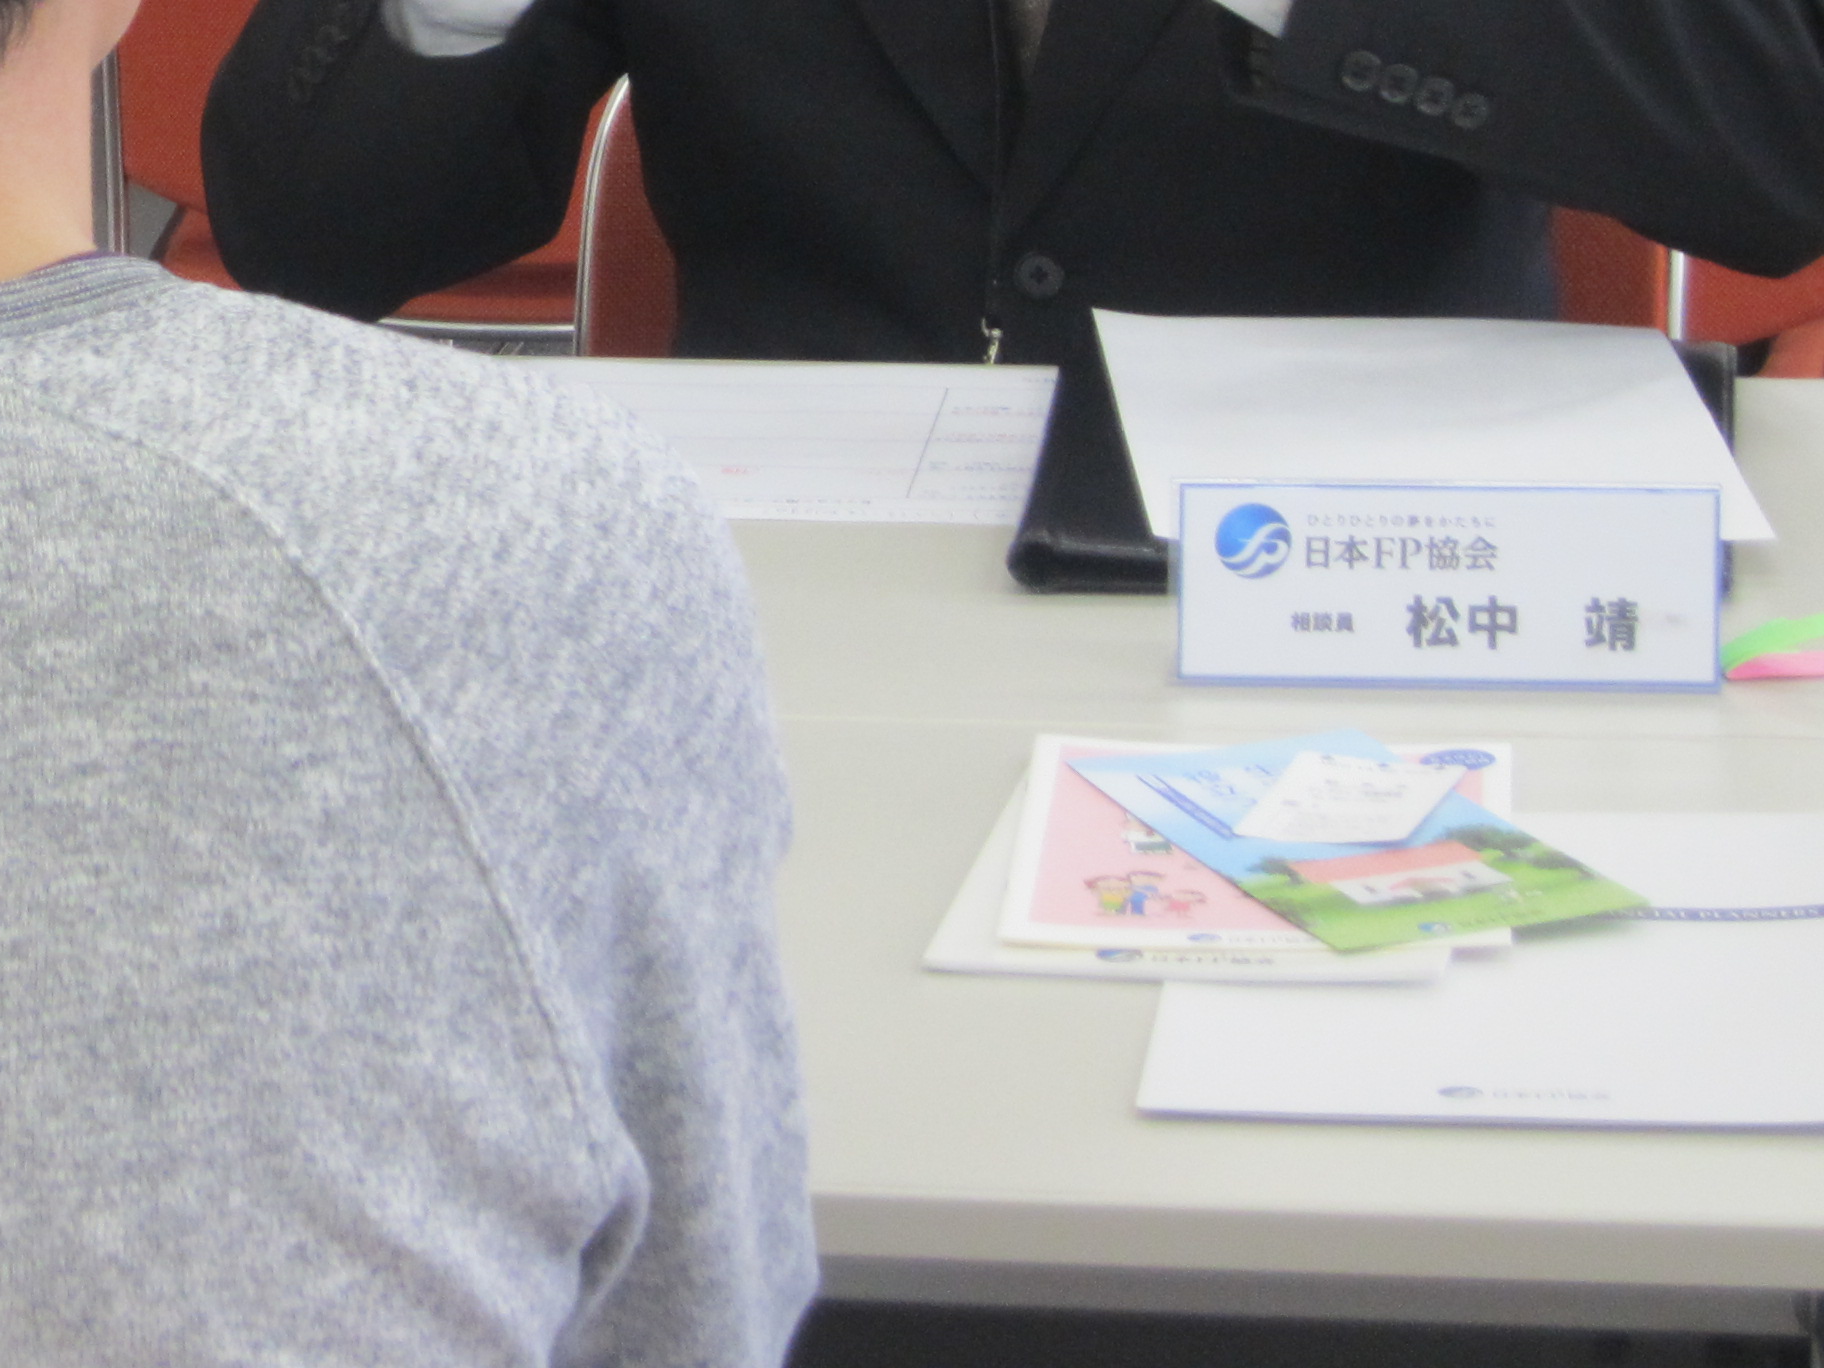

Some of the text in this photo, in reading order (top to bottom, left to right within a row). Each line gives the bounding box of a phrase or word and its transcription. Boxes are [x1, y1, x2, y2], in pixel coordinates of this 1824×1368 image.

[1307, 514, 1497, 528] ひとりひとりの夢をかたちに
[1305, 535, 1498, 570] 日本FP協会
[1291, 595, 1639, 650] 相談員 松中 靖
